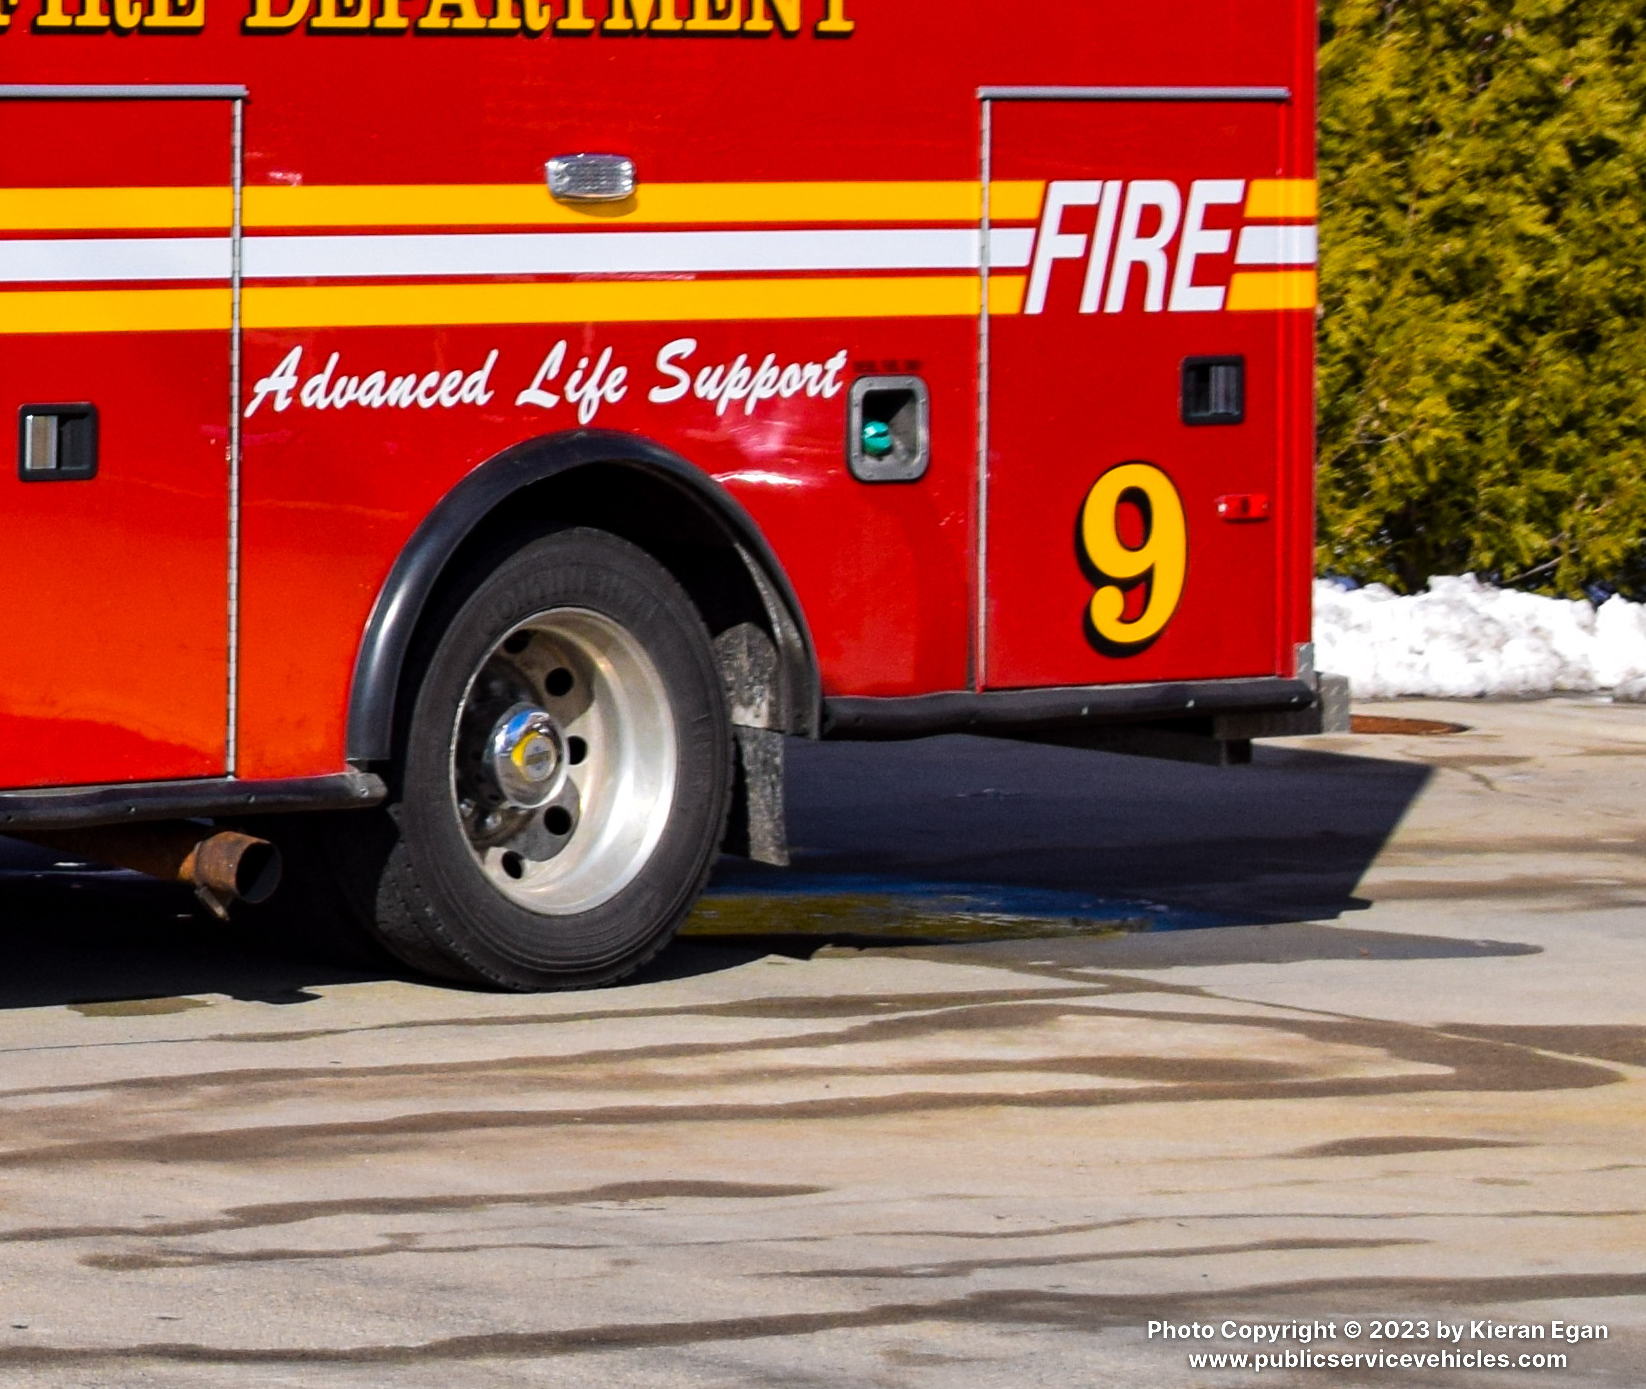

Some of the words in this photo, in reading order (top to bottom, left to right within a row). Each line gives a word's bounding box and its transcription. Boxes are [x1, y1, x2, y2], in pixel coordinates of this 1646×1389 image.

[1023, 179, 1247, 315] FIRE
[244, 345, 499, 418] Advanced
[516, 340, 628, 425] Life
[649, 338, 848, 416] Support
[1082, 463, 1187, 644] 9
